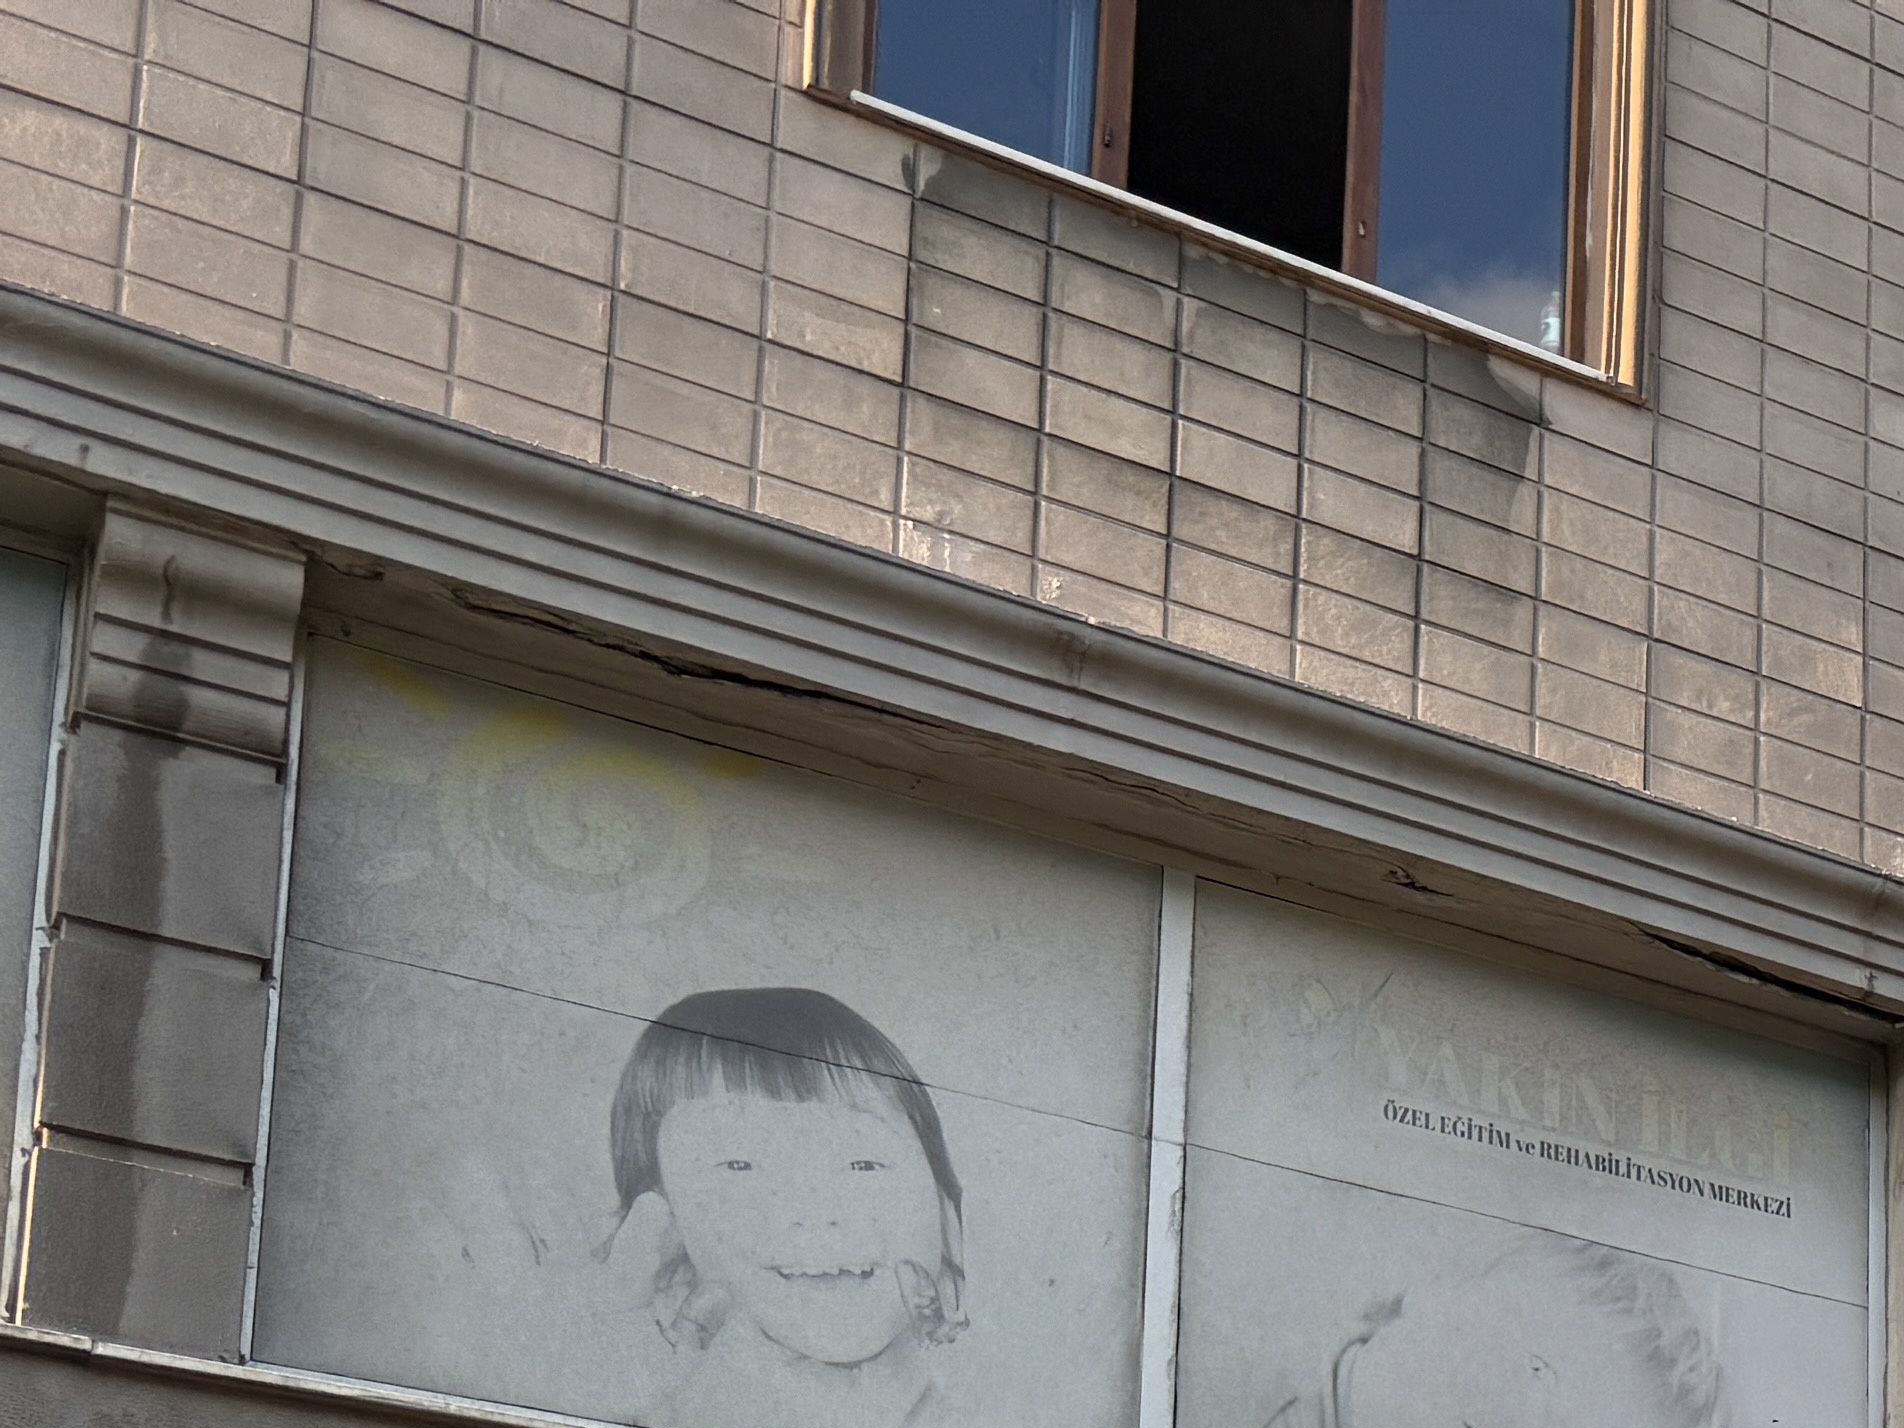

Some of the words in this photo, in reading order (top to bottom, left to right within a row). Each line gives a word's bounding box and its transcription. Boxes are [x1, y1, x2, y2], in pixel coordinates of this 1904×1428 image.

[1383, 1100, 1436, 1132] ÖZEL
[1440, 1115, 1511, 1151] EĞİTİM
[1515, 1137, 1535, 1156] ve
[1539, 1140, 1705, 1198] REHABİLİTASYON
[1708, 1182, 1791, 1218] MERKEZİ
